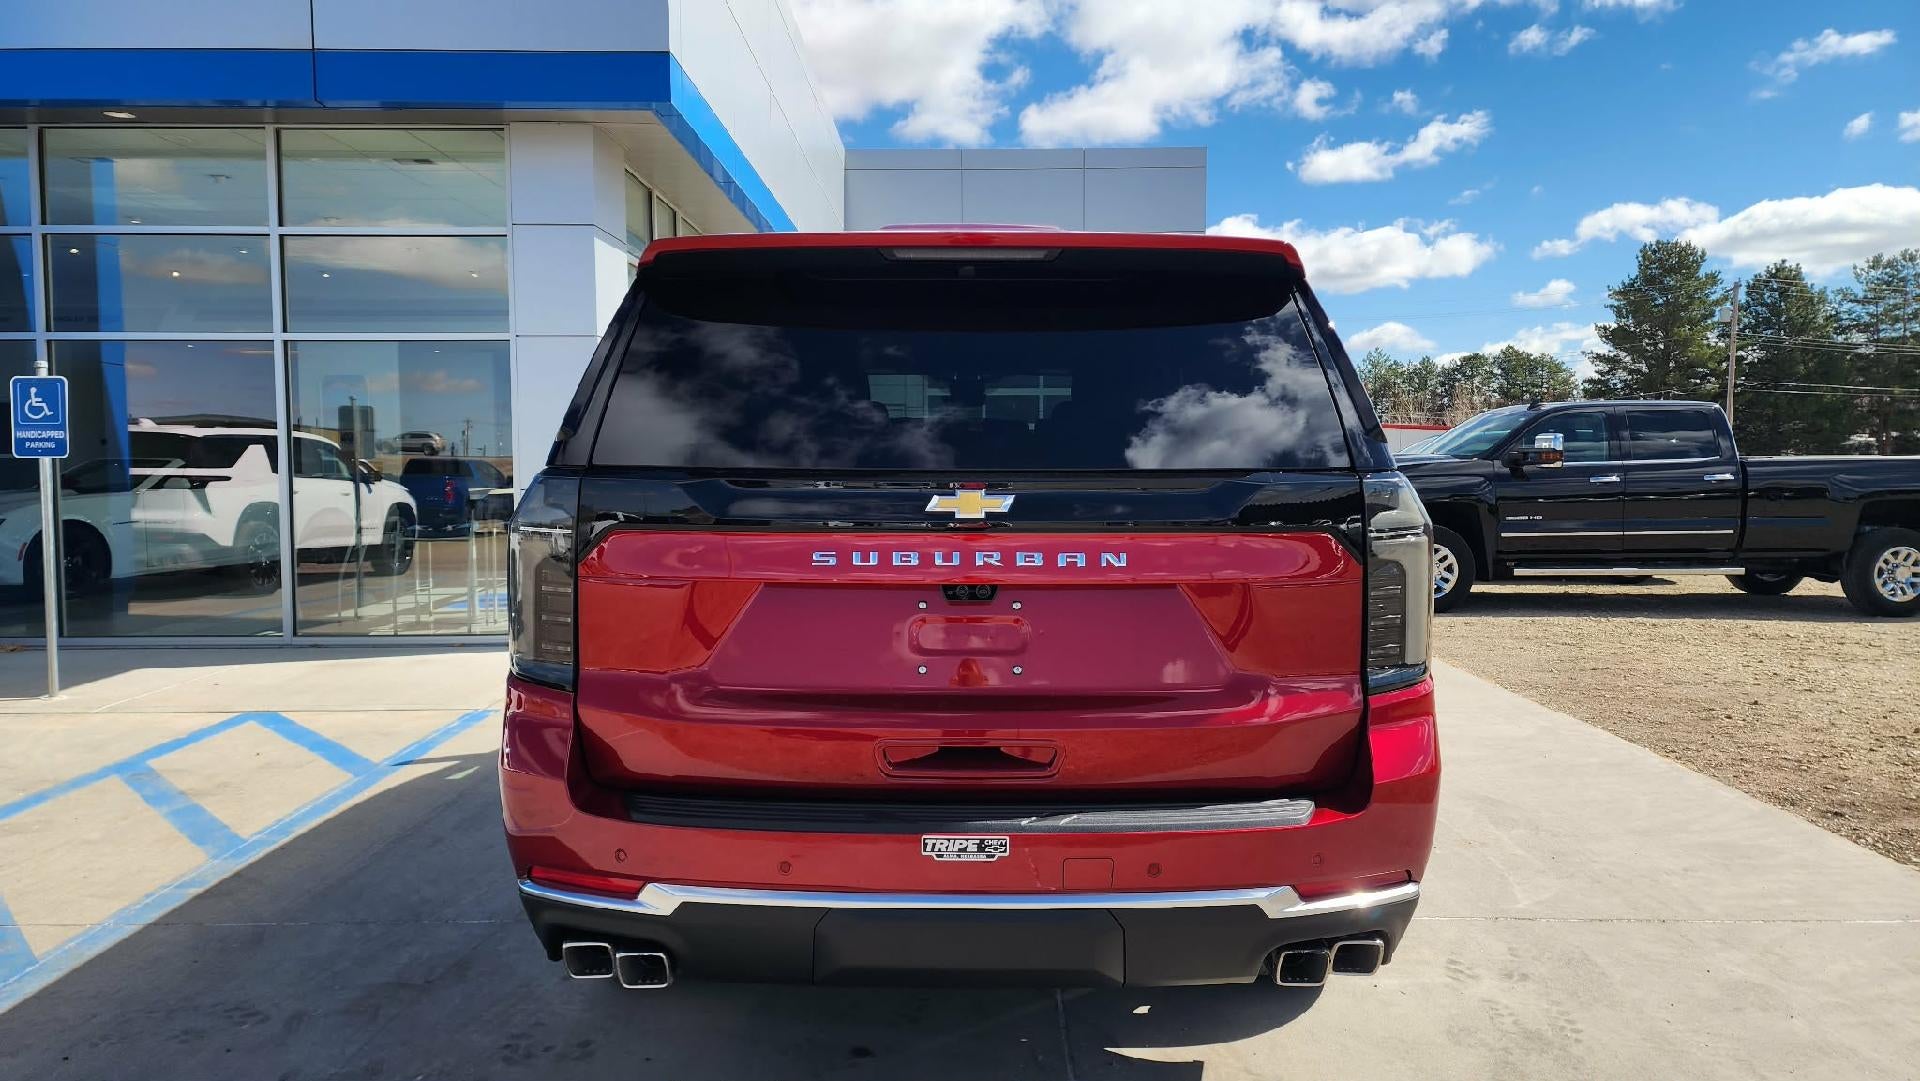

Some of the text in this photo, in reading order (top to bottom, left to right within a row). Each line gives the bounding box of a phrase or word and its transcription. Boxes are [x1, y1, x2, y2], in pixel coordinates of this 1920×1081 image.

[16, 430, 65, 439] HANDICAPPED
[25, 441, 56, 449] PARKING
[811, 551, 1128, 567] SUBURBAN
[924, 839, 980, 852] TRIPE
